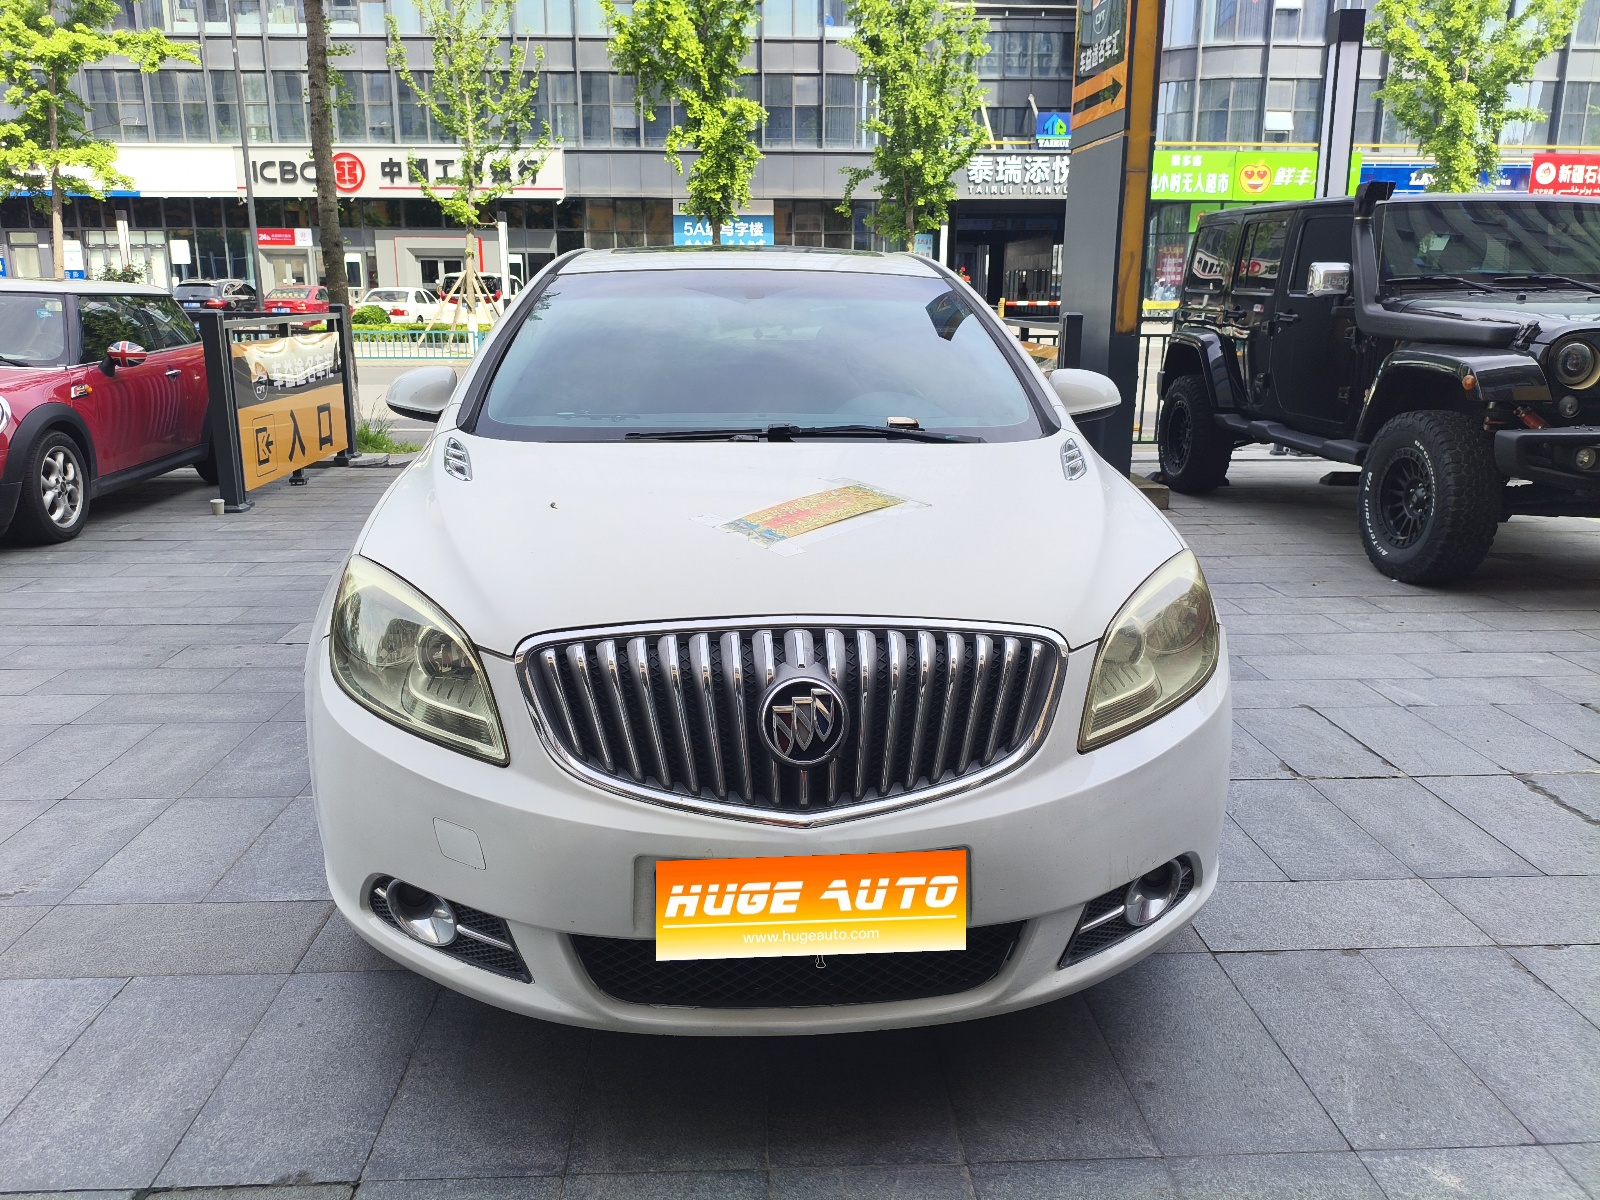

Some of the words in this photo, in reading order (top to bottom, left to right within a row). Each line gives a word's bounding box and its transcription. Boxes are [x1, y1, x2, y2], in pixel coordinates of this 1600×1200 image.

[1038, 140, 1070, 148] TAIRUI
[251, 160, 318, 184] ICBC
[1558, 164, 1600, 184] 新疆石
[968, 186, 1013, 195] TAIRUI
[288, 402, 333, 462] 入口
